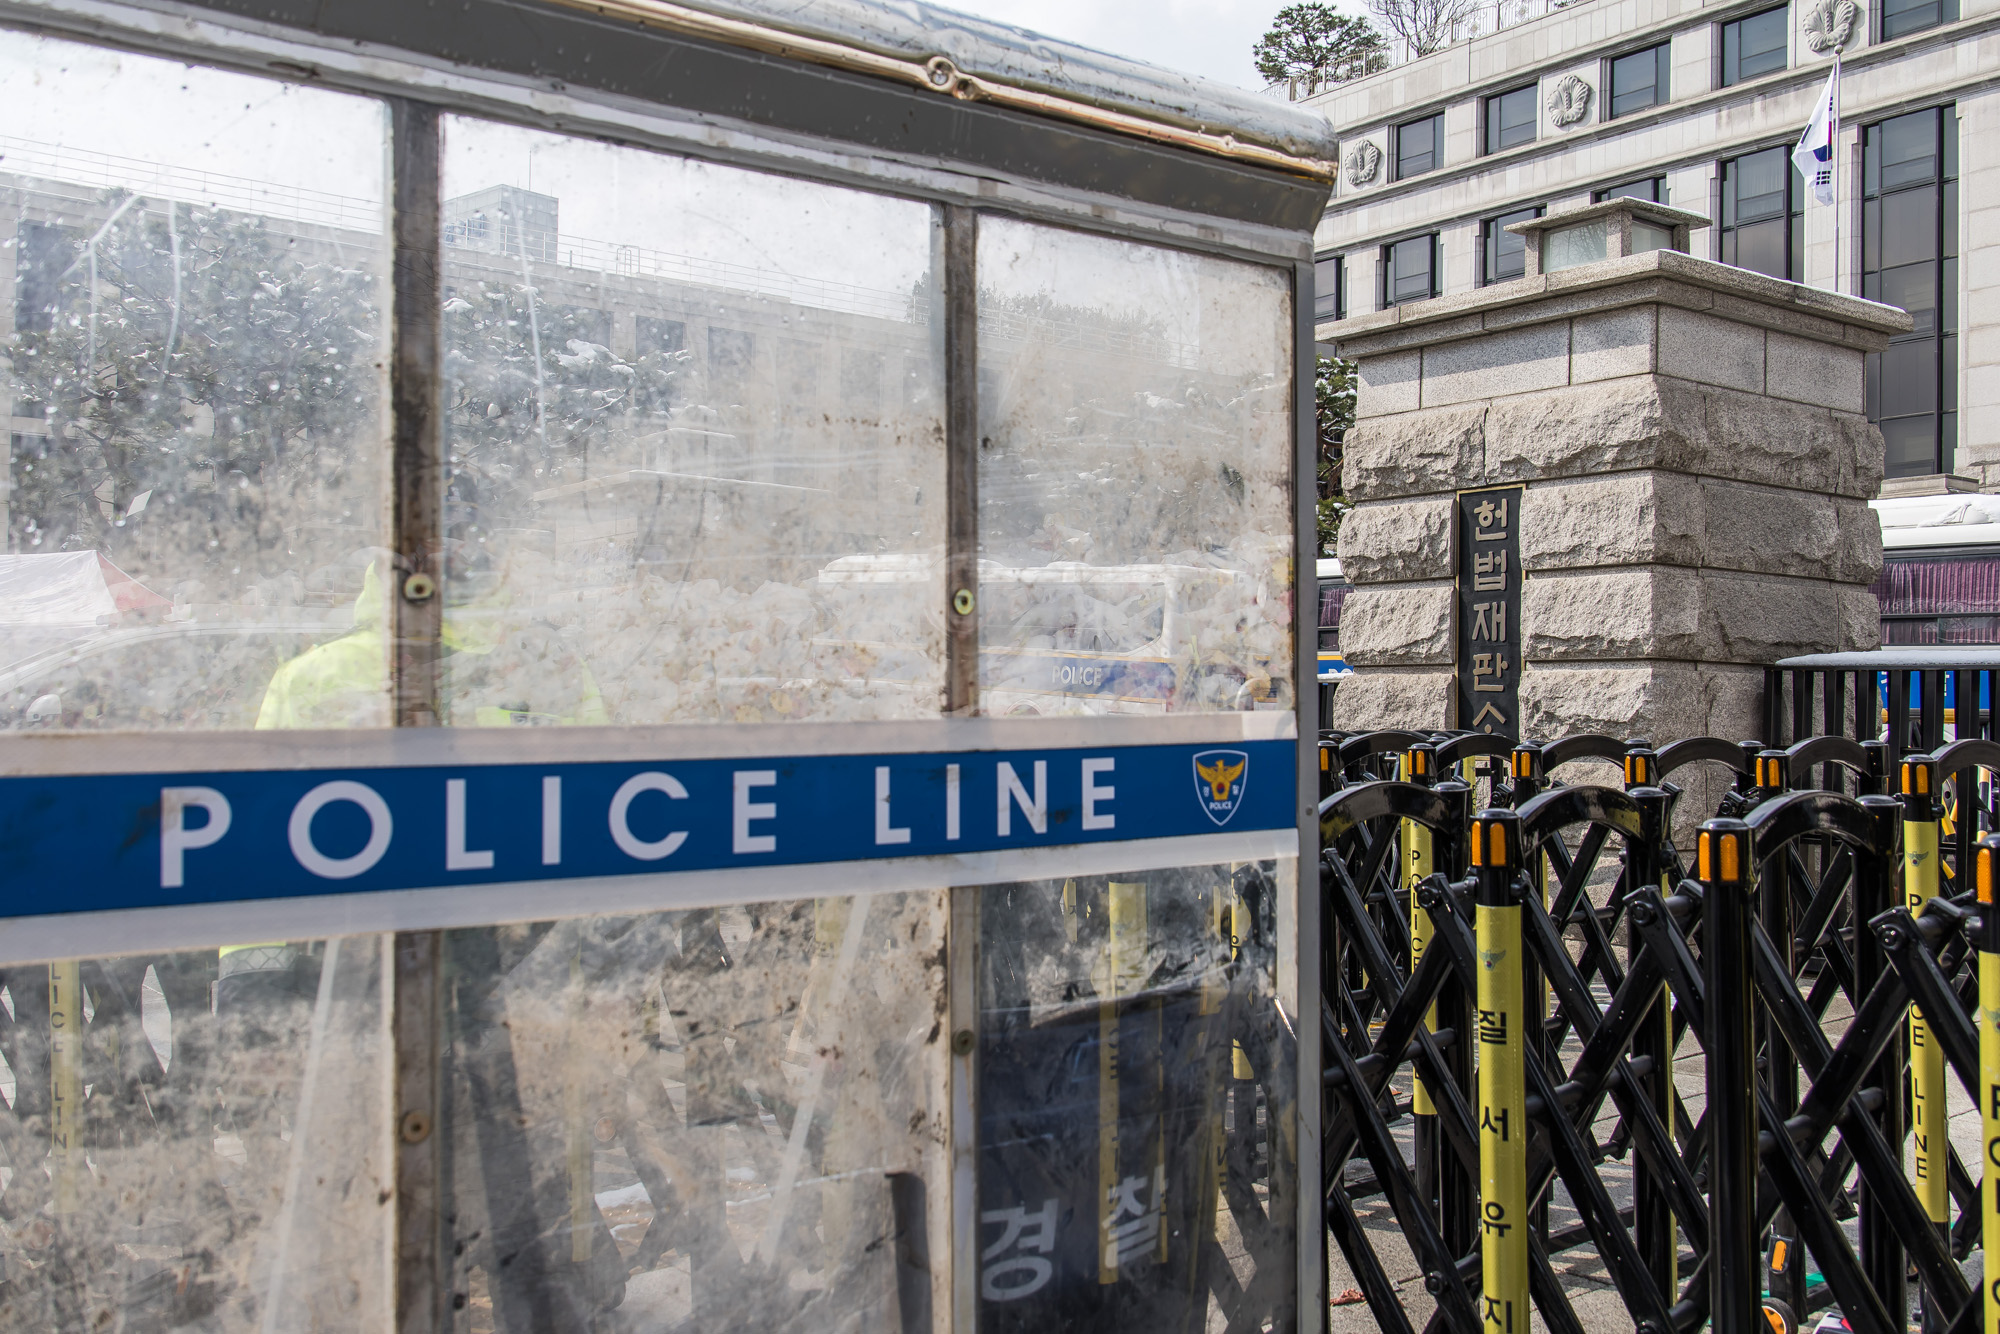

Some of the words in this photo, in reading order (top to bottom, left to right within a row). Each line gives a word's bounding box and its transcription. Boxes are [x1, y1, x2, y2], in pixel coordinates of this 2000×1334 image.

[1052, 665, 1102, 687] POLICE
[159, 769, 778, 889] POLICE
[874, 755, 1116, 847] LINE
[1209, 801, 1232, 810] POLICE
[51, 961, 64, 1053] LICE
[1913, 1077, 1928, 1180] LINE
